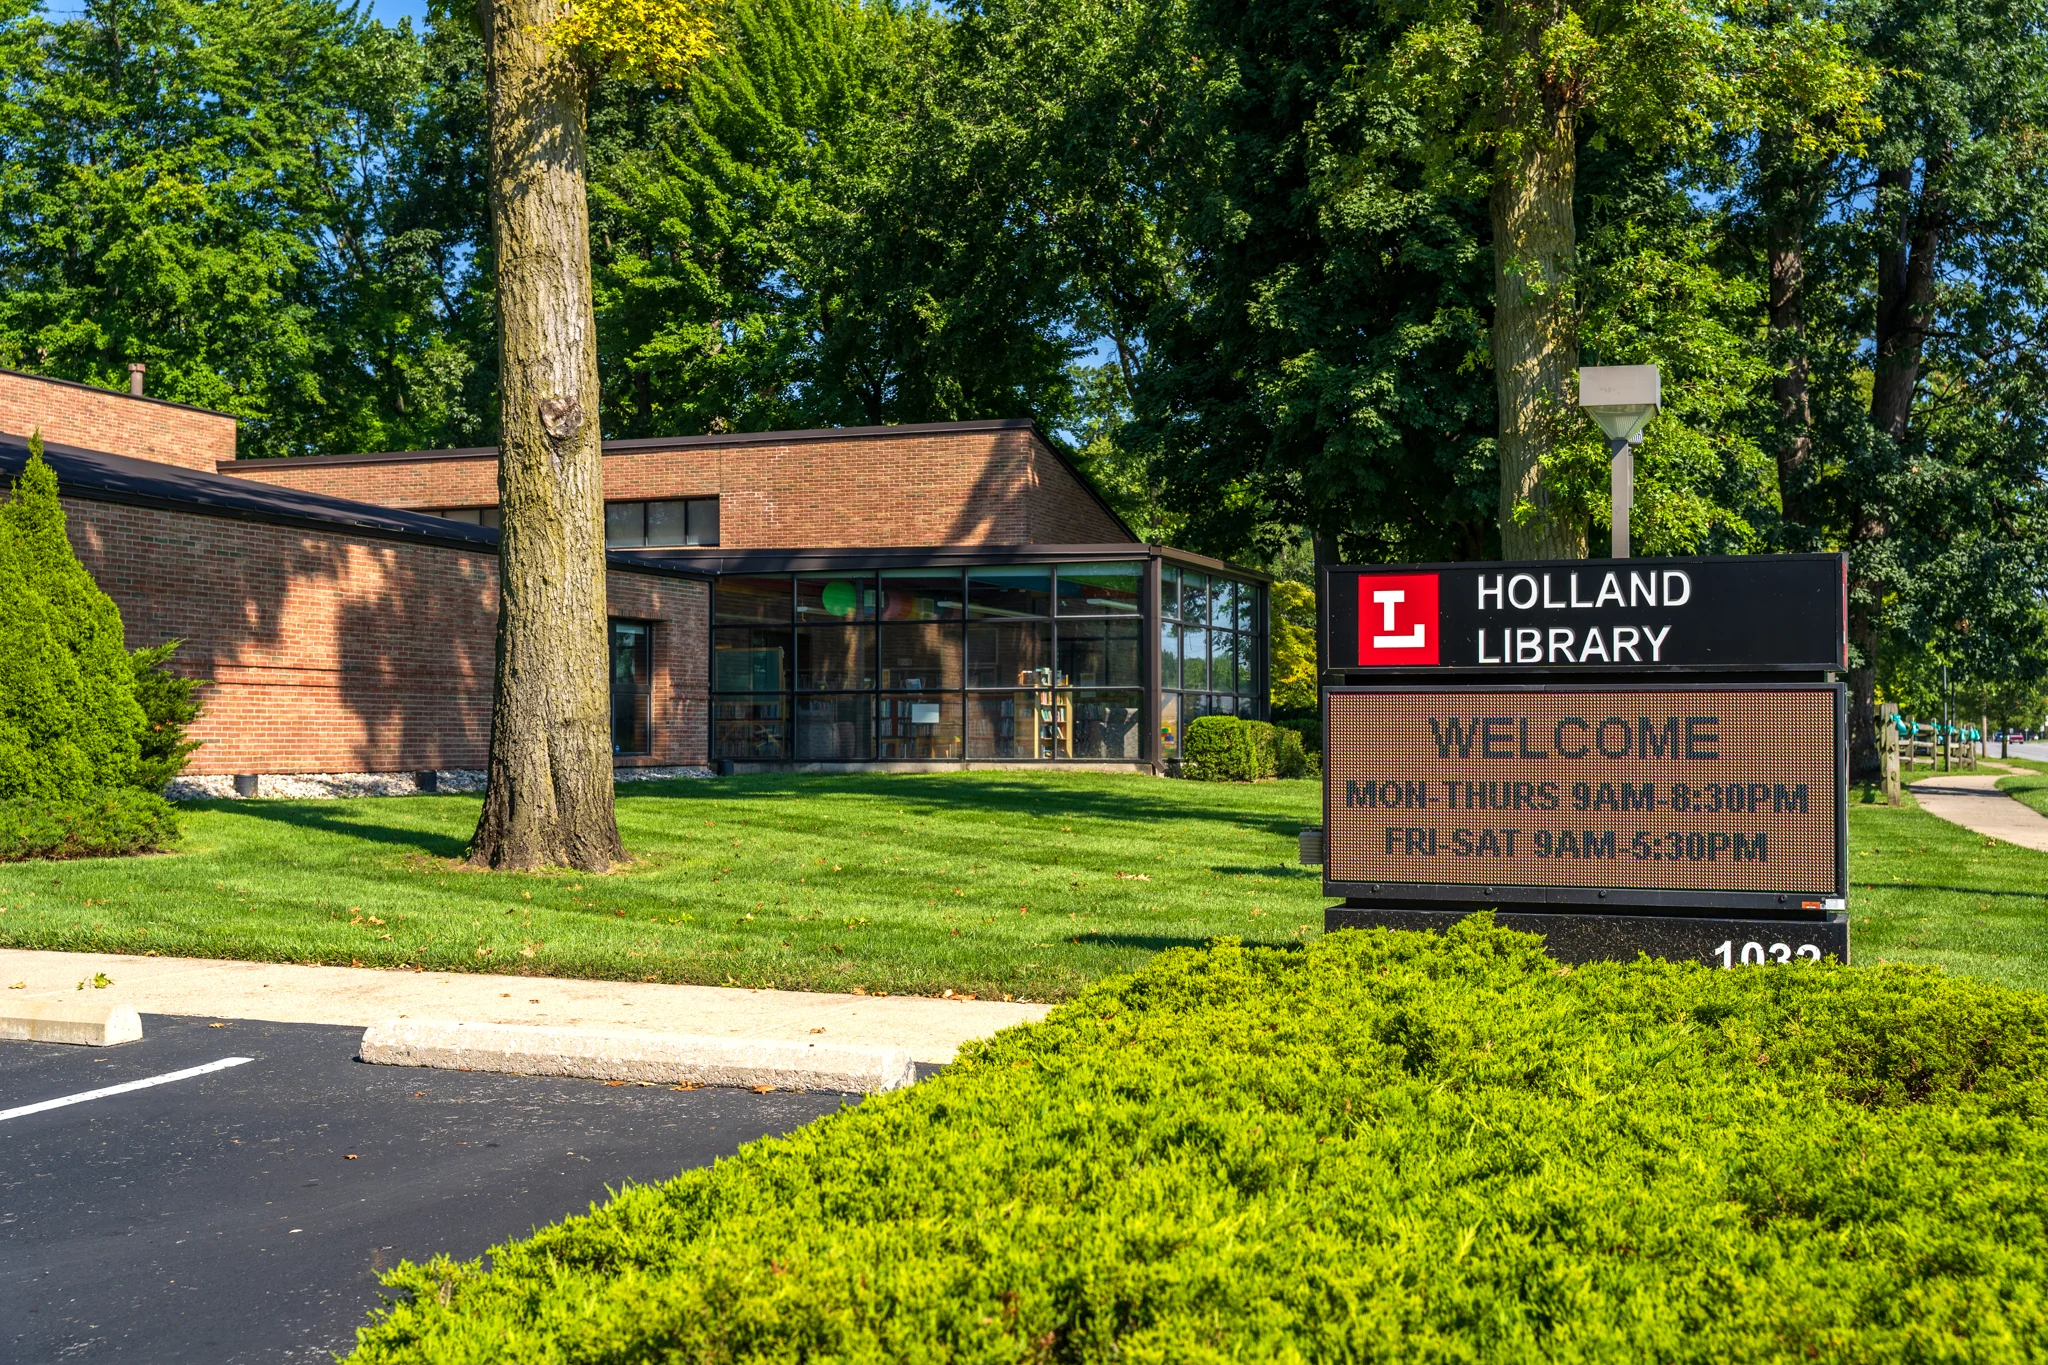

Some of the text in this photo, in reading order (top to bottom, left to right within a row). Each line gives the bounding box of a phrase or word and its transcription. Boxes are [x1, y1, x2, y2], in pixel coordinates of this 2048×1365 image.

[1478, 570, 1692, 610] HOLLAND
[1478, 625, 1672, 664] LIBRARY
[1428, 716, 1719, 760] WELCOME
[1346, 780, 1808, 814] MON-THURS 9AM-8:30PM
[1386, 827, 1767, 863] FRI-SAT 9AM-5:30PM
